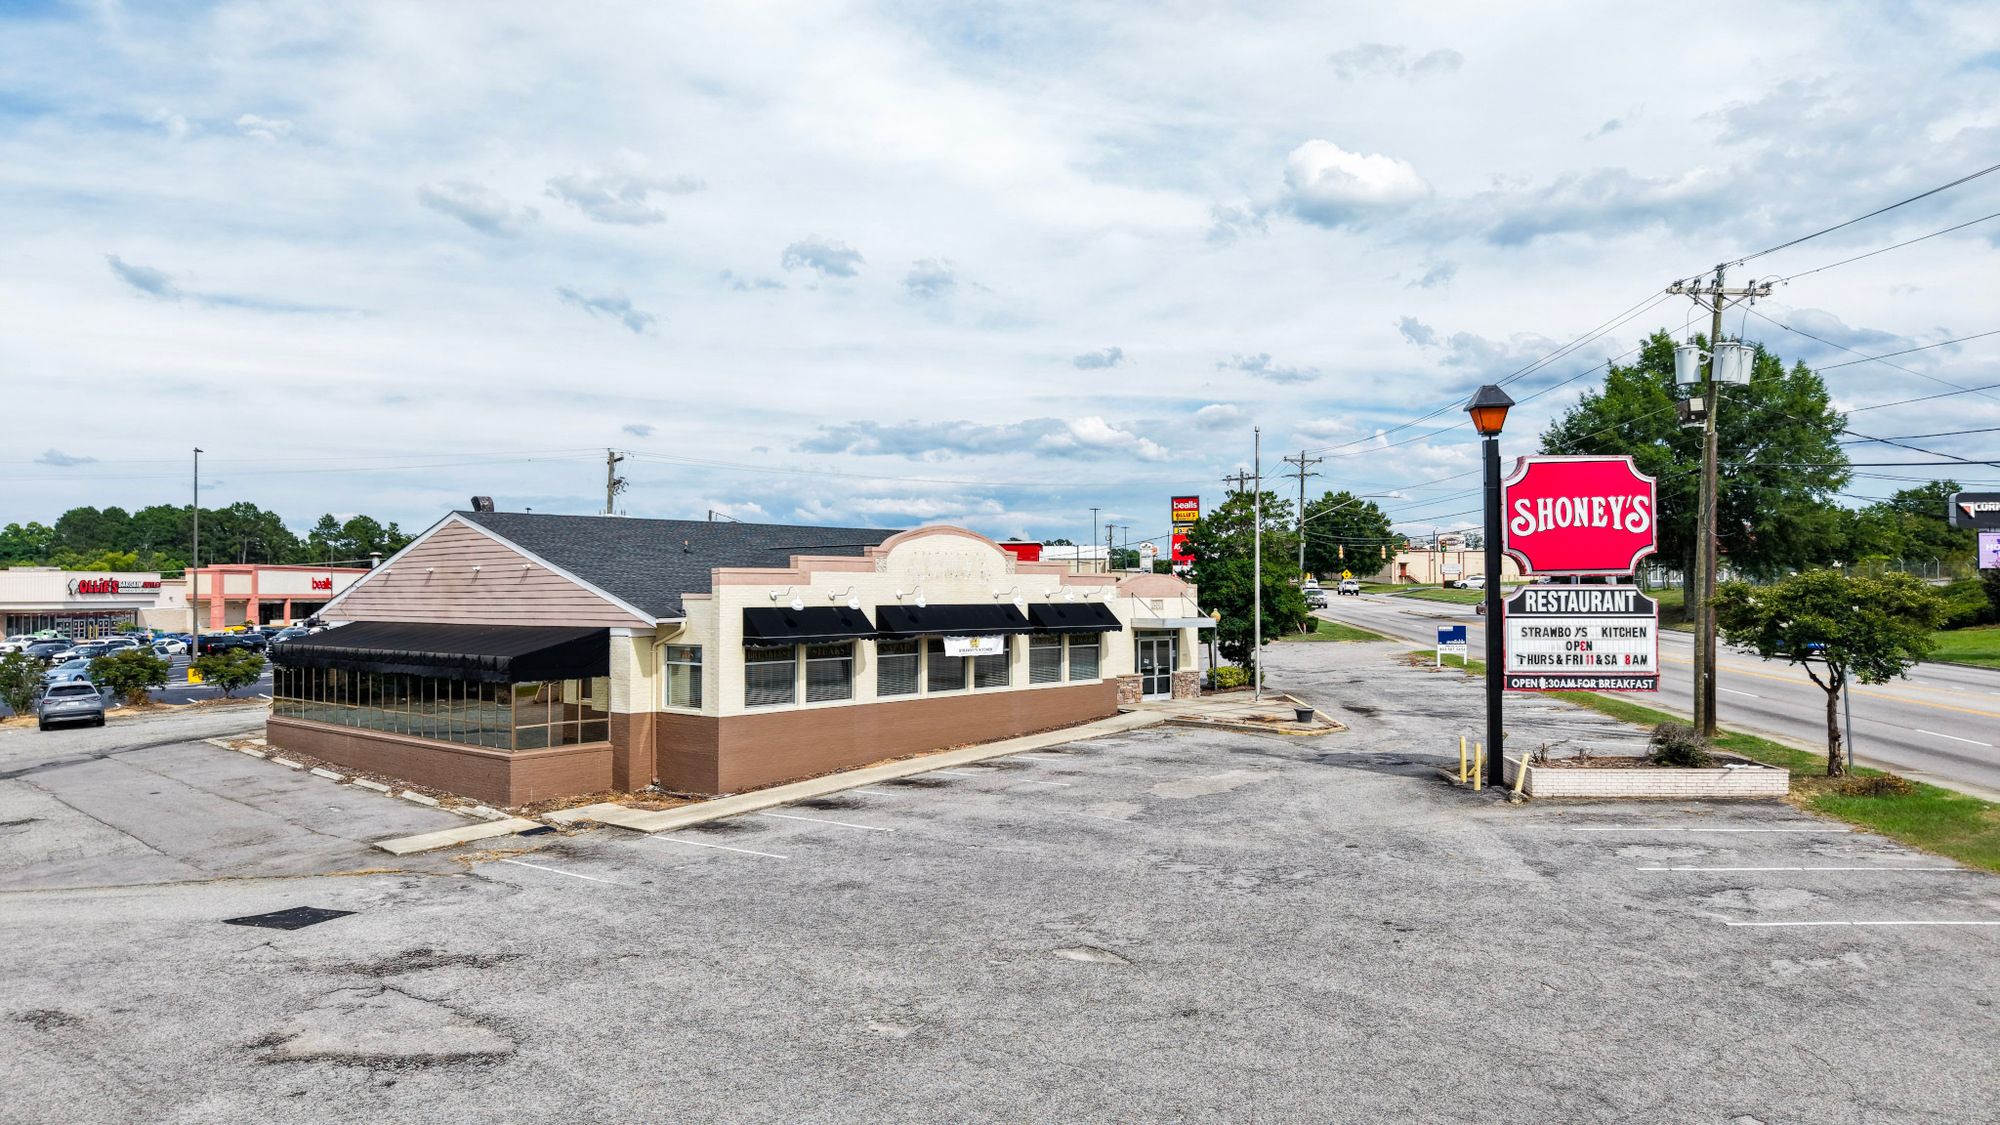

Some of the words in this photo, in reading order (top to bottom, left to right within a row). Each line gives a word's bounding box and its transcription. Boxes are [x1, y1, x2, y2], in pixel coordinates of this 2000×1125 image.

[1173, 501, 1197, 509] bealls
[1511, 495, 1650, 537] SHONEY'S
[1525, 591, 1637, 612] RESTAURANT
[1601, 626, 1647, 638] KITCHEN
[1565, 640, 1592, 651] OPEN
[1511, 679, 1538, 688] OPEN
[1577, 679, 1597, 688] FOR
[1599, 679, 1654, 689] BREAKFAST
